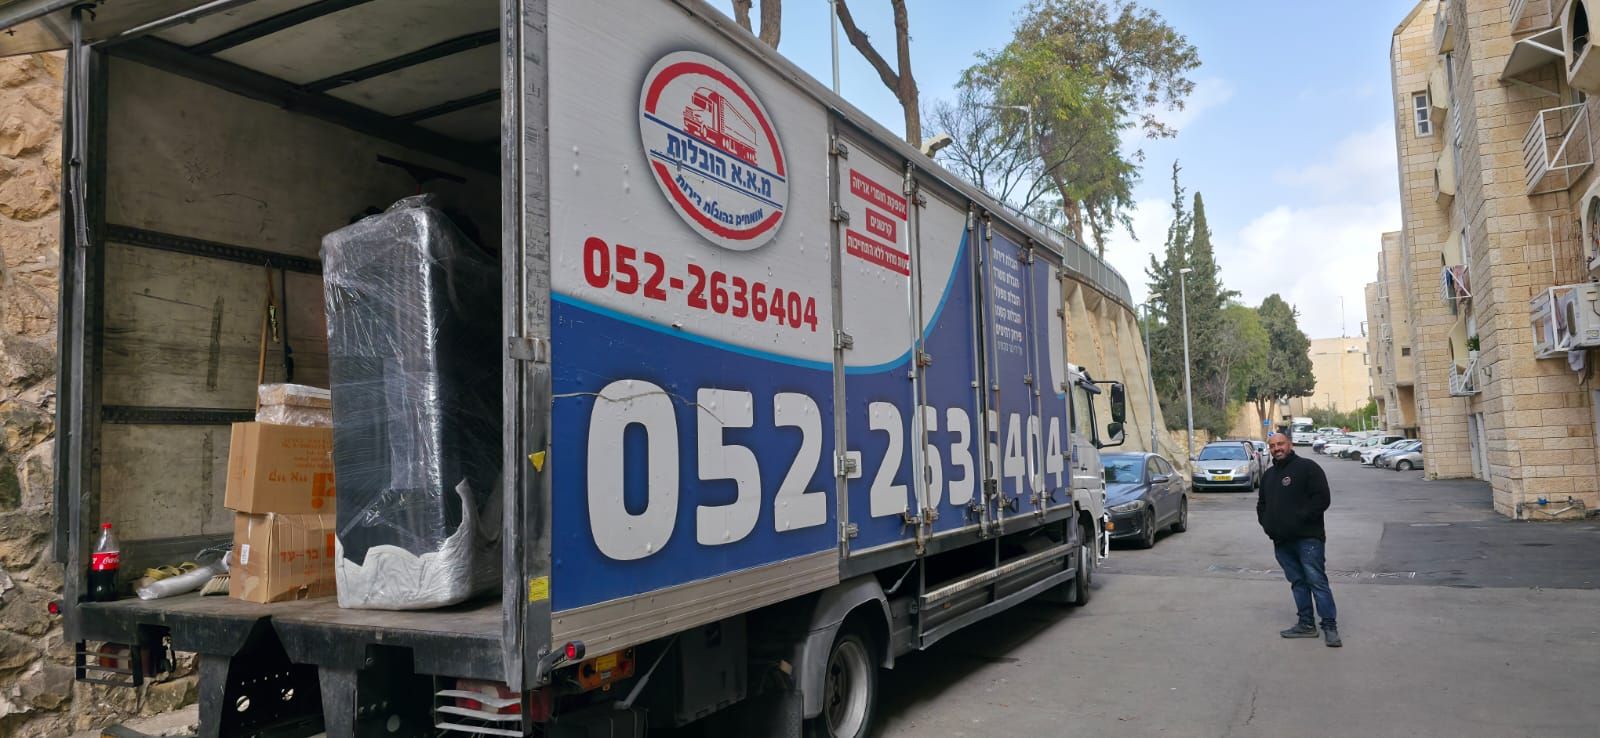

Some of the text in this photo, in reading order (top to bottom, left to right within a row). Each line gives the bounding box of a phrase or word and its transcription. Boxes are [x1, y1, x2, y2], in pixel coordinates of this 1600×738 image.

[667, 133, 772, 198] מ.א.א הובלות
[675, 174, 702, 207] דירות
[852, 176, 906, 215] אספקת חומרי אריזה
[870, 216, 893, 238] קרטונים
[847, 235, 874, 257] התחייבות
[874, 245, 885, 261] ללא
[583, 236, 818, 333] 052-2636404
